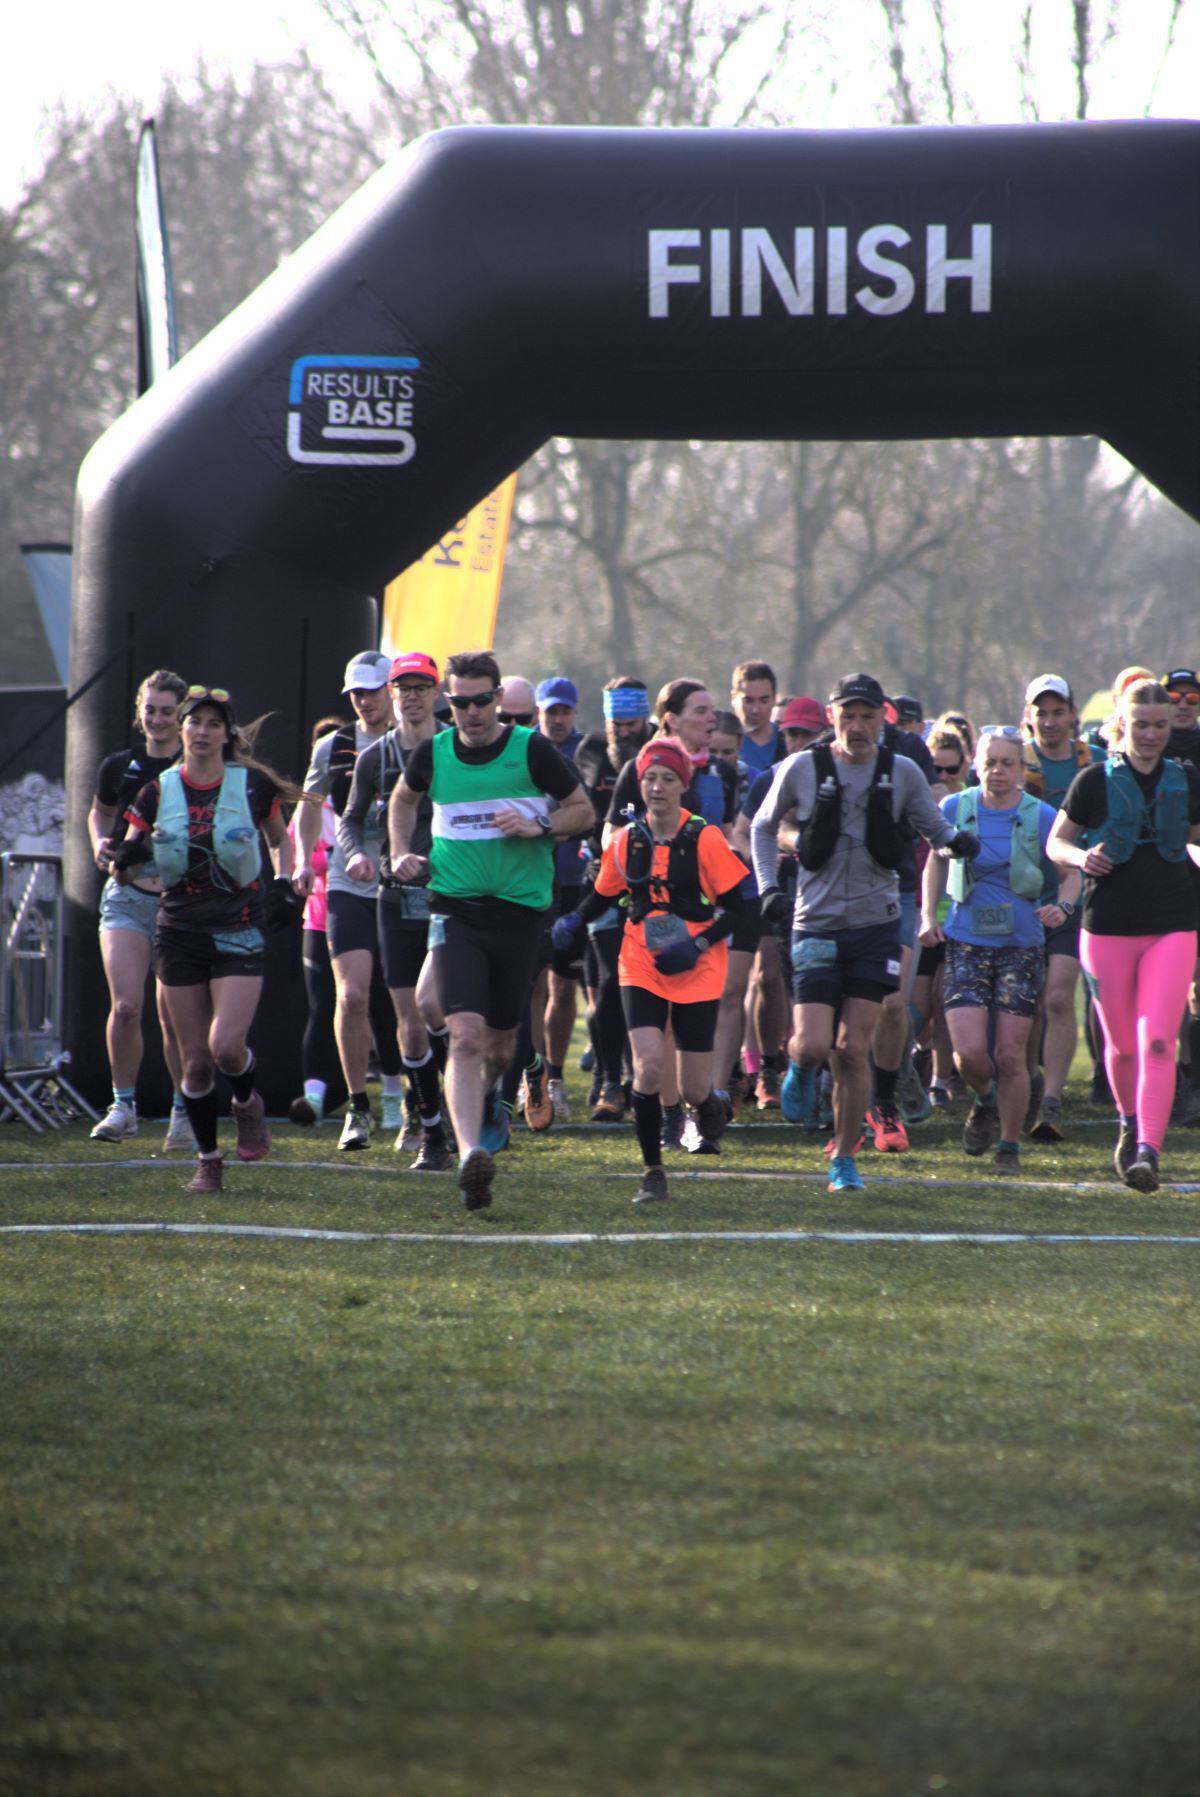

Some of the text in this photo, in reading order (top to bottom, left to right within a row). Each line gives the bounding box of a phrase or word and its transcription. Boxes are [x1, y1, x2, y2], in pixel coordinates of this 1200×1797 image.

[648, 223, 992, 318] FINISH
[307, 373, 415, 399] RESULTS
[327, 399, 414, 427] BASE
